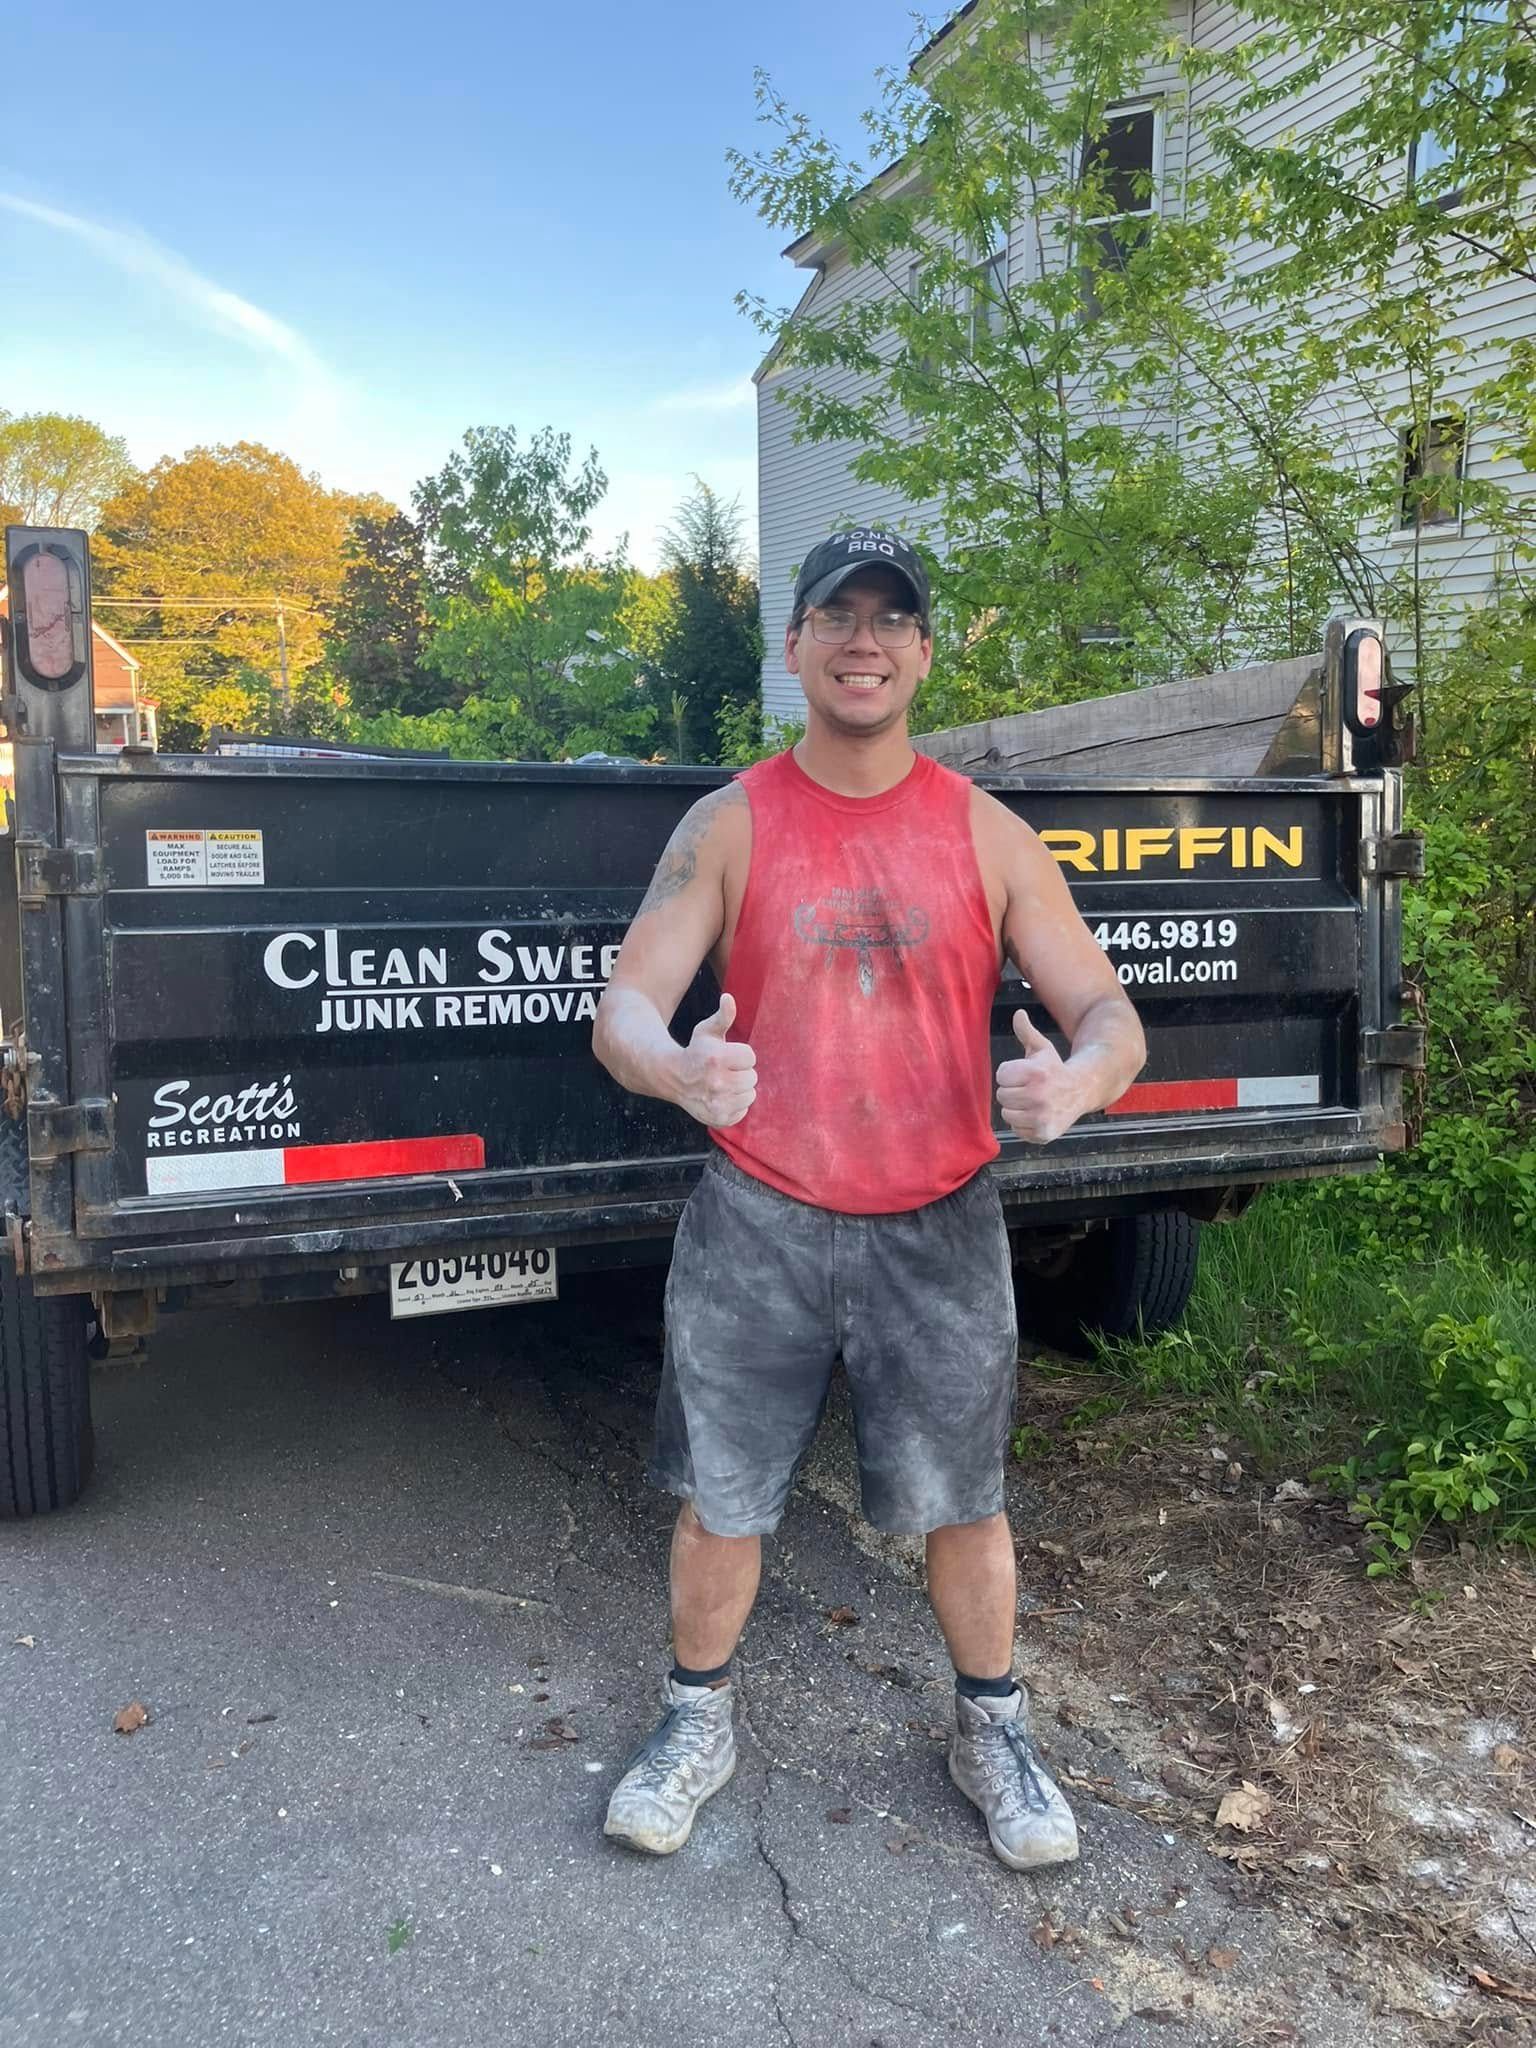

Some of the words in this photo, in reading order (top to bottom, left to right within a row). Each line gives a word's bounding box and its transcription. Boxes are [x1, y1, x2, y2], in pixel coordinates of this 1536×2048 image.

[848, 541, 895, 557] BBQ
[1038, 826, 1302, 872] RIFFIN
[1093, 919, 1238, 951] 446.9819
[478, 929, 622, 983] SWEE
[1116, 956, 1238, 985] oval.com
[316, 997, 424, 1032] JUNK
[436, 991, 602, 1027] REMOVA
[148, 1074, 298, 1128] Scott's
[146, 1123, 301, 1148] RECREATION
